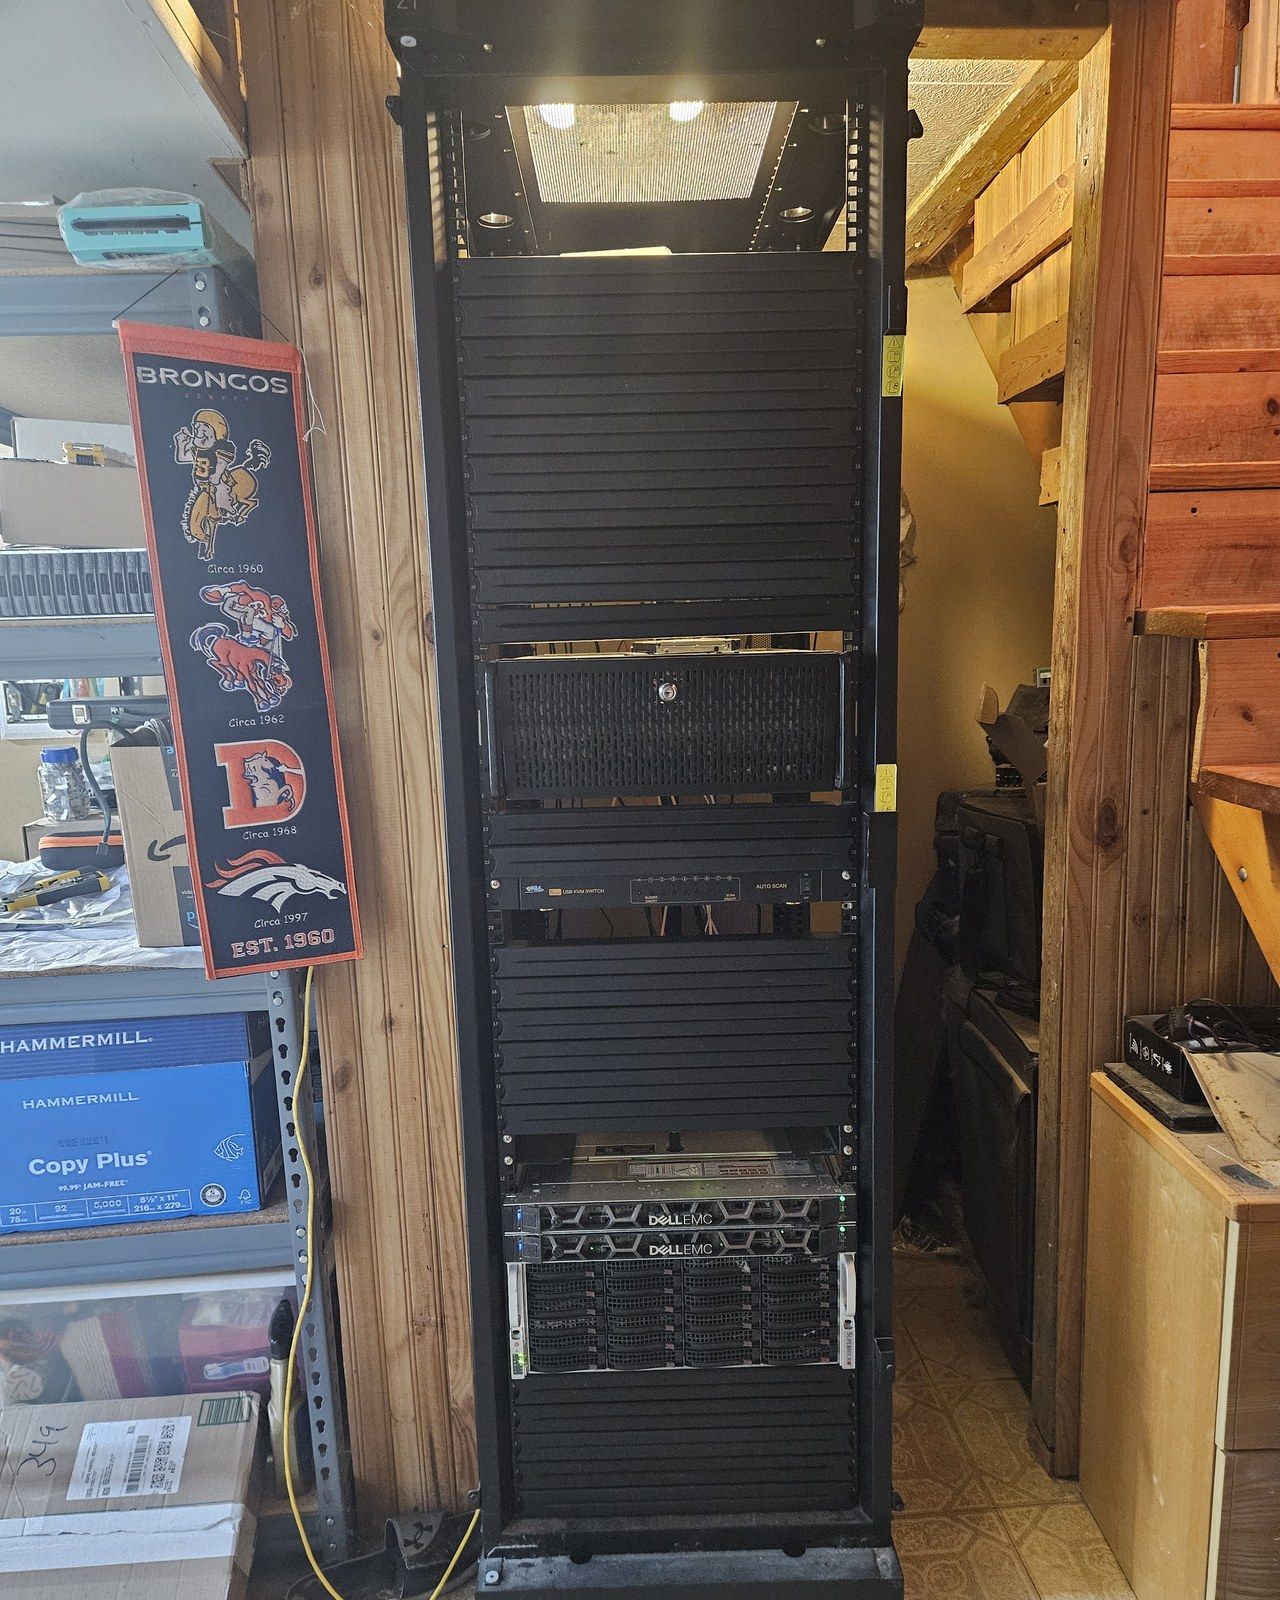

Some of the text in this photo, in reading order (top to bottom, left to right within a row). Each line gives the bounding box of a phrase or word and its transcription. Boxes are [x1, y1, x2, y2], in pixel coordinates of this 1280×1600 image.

[136, 366, 289, 394] BRONCOS
[207, 564, 264, 574] Circa 1960
[229, 714, 285, 728] Circa 1962
[242, 826, 297, 840] Circa 1968
[254, 912, 308, 929] Circa 1997
[231, 928, 335, 959] EST. 1960
[0, 1030, 153, 1053] HAMMERMILL
[22, 1092, 140, 1110] HAMMERMILL
[29, 1151, 149, 1176] Copy Plus
[54, 1204, 68, 1213] 92
[94, 1200, 122, 1210] 5,000
